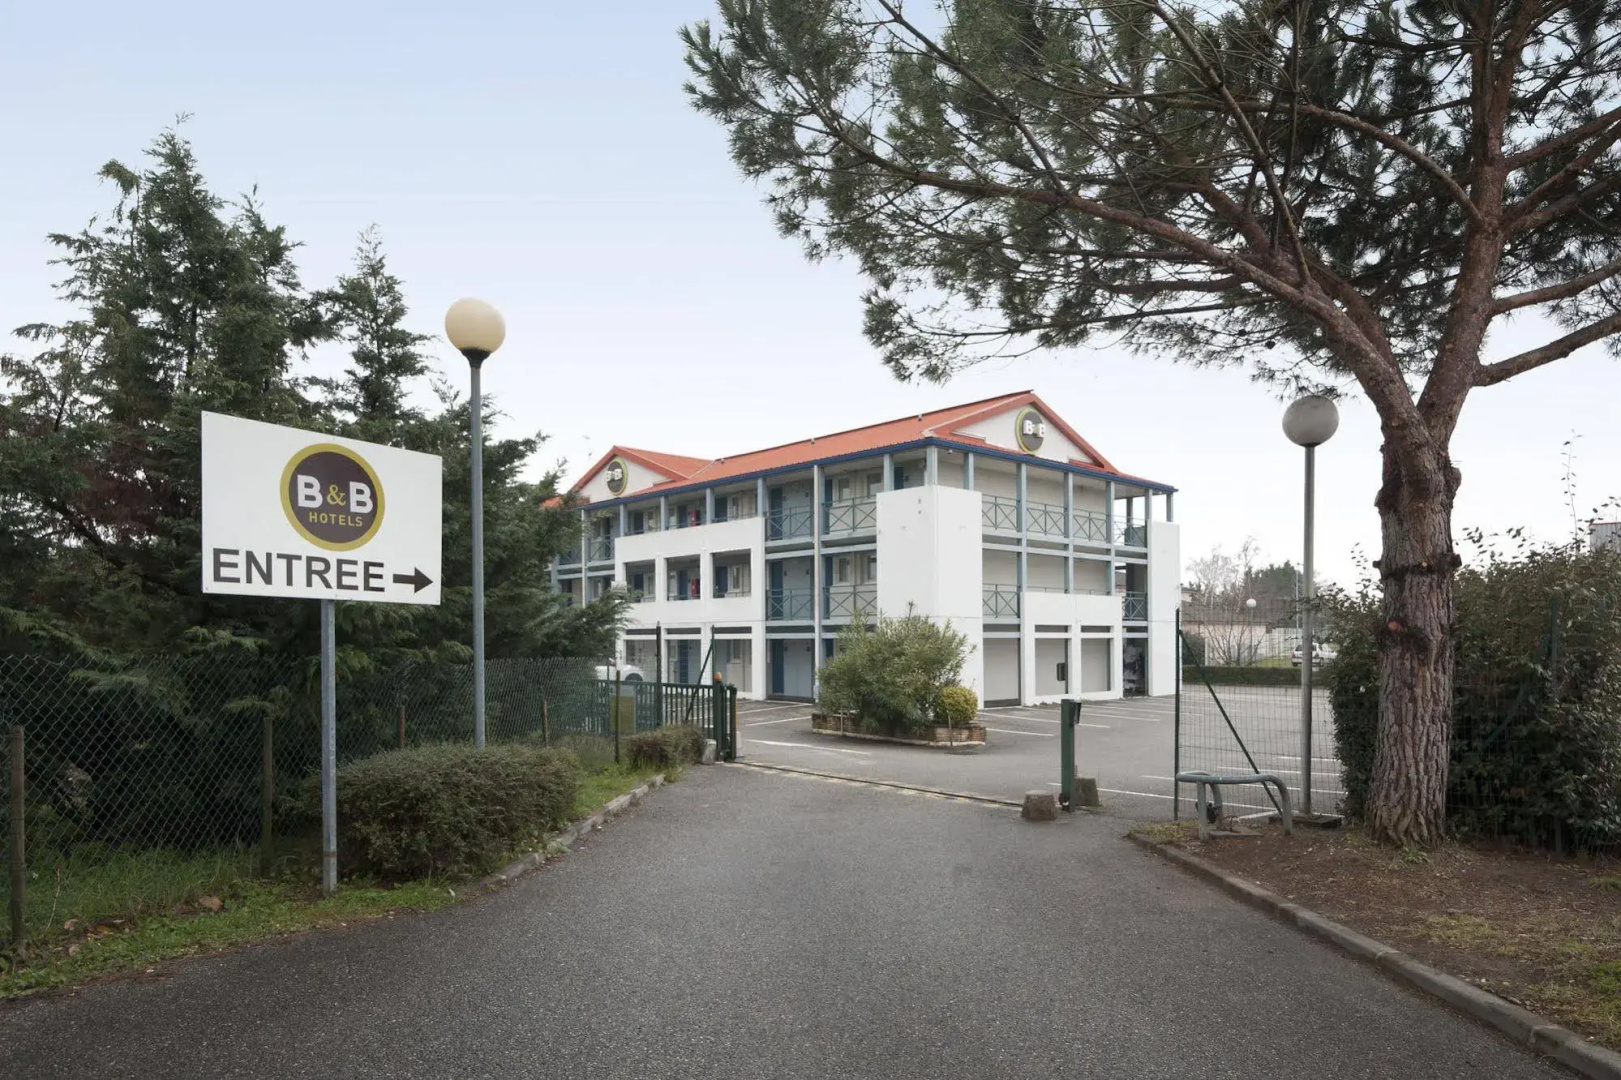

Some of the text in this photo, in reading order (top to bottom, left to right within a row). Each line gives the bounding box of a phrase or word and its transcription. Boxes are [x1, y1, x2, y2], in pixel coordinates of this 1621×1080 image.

[297, 474, 373, 514] B&B
[309, 511, 363, 527] HOTELS
[212, 547, 385, 592] ENTREE
